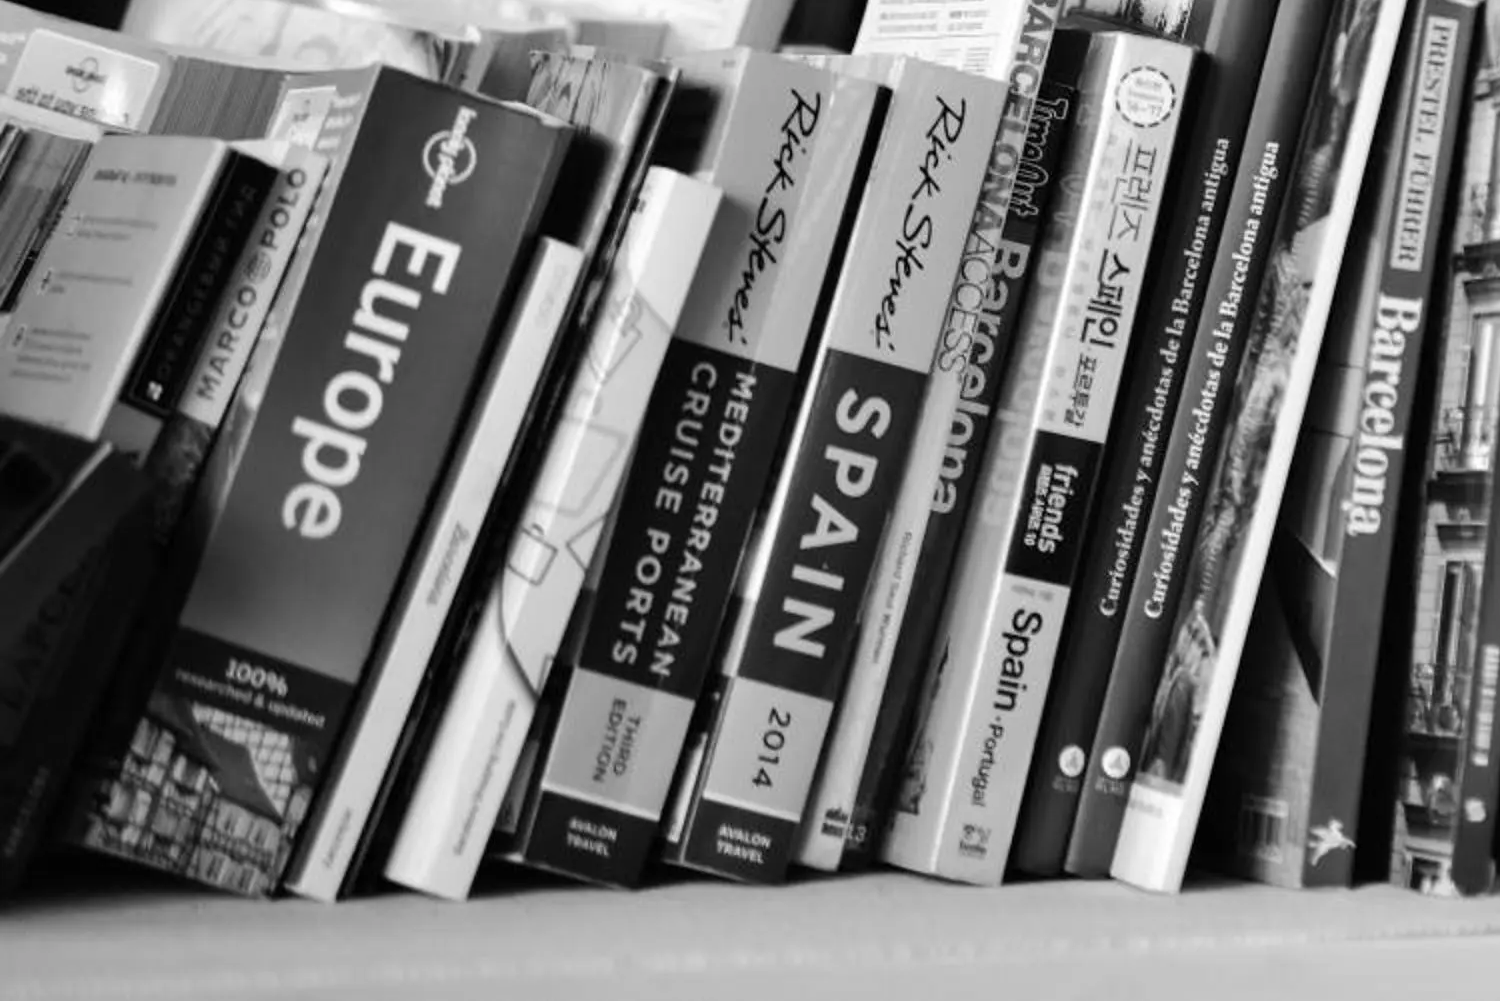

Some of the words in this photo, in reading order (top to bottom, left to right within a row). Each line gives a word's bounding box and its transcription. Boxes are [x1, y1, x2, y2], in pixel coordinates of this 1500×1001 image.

[1416, 24, 1449, 142] PRESTEL
[766, 88, 821, 195] Rick
[912, 96, 966, 200] Rick
[1107, 138, 1157, 242] 프렌즈
[1200, 137, 1229, 212] antigua
[1247, 140, 1279, 217] antigua
[199, 284, 257, 401] MARCO
[262, 167, 307, 252] POLO
[936, 228, 996, 375] ACCESS
[1080, 248, 1130, 348] 스페인
[1171, 212, 1210, 315] Barcelona
[1218, 215, 1260, 319] Barcelona
[1158, 335, 1181, 365] de
[1165, 315, 1186, 337] la
[1205, 337, 1230, 368] de
[1212, 318, 1234, 340] la
[281, 220, 462, 539] Europe
[930, 241, 1031, 514] Barcelona
[1137, 366, 1174, 468] anécdotas
[1183, 368, 1222, 471] anécdotas
[1342, 294, 1422, 537] Barcelona
[655, 362, 717, 514] CRUISE
[1133, 467, 1153, 486] y
[1179, 469, 1200, 487] y
[650, 371, 756, 677] MEDITERRANEAN
[773, 387, 891, 659] SPAIN
[1038, 463, 1078, 553] friends
[1098, 483, 1145, 618] Curiosidades
[1143, 485, 1192, 620] Curiosidades
[612, 527, 670, 666] PORTS
[226, 657, 288, 699] 100%
[994, 609, 1043, 713] Spain
[593, 699, 626, 784] EDITION
[612, 716, 640, 777] THIRD
[752, 708, 791, 788] 2014
[969, 723, 1005, 808] Portugal
[567, 832, 610, 858] TRAVEL
[569, 817, 618, 843] AVALON
[717, 840, 765, 865] TRAVEL
[719, 824, 771, 850] AVALON
